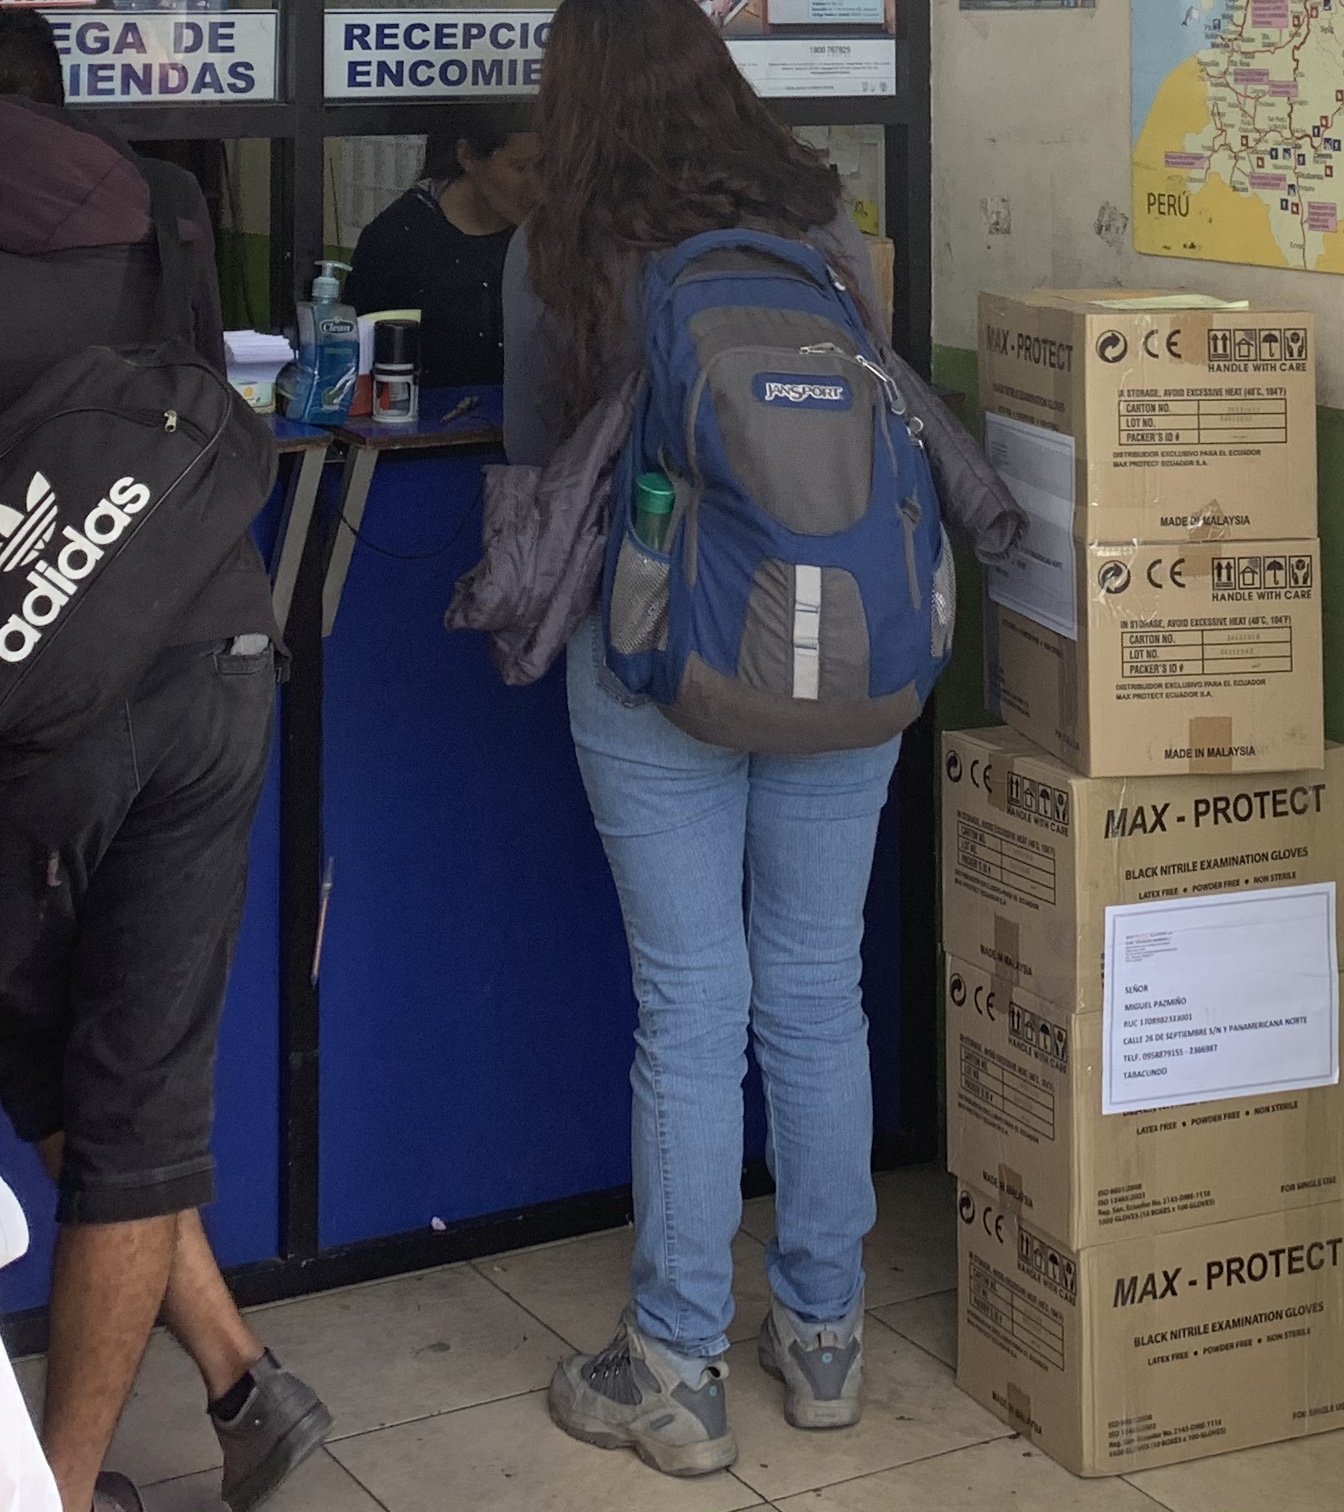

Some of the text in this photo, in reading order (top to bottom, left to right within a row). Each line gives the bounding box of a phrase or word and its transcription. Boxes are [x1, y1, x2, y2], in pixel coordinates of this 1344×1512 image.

[173, 21, 236, 54] DE
[343, 22, 553, 51] RECEPCIO
[347, 59, 542, 88] ENCOMIE
[1146, 191, 1189, 218] PERÚ
[322, 320, 351, 333] Clean
[1016, 332, 1073, 372] PROTECT
[1208, 362, 1307, 373] HANDLE WITH CARE
[765, 381, 844, 401] JANSPORT
[1126, 403, 1171, 413] CARTON NO.
[1212, 590, 1312, 601] HANDLE WITH CARE
[1167, 617, 1246, 628] AVOID EXCESSIVE HEAT
[1129, 634, 1175, 644] CARTON NO.
[1129, 649, 1160, 659] LOT NO.
[1129, 665, 1178, 674] PACKER'S ID
[1164, 746, 1255, 759] MADE IN MALAYSIA
[1103, 802, 1170, 840] MAX
[1193, 784, 1326, 828] PROTECT
[1125, 846, 1309, 881] BLACK NITRILE EXAMINATION GLOVES
[1138, 870, 1296, 901] LATEX FREE POWDER FREE NON STERILE
[1125, 984, 1149, 994] SEÑOR
[1123, 1036, 1143, 1045] CALLE
[1155, 1033, 1164, 1042] DE
[1166, 1027, 1208, 1040] SEPTIEMBRE
[1209, 1025, 1222, 1035] S/N
[1228, 1018, 1284, 1033] PANAMERICANA
[1284, 1016, 1308, 1026] NORTE
[1123, 1067, 1168, 1079] TABACUNDO
[1112, 1267, 1182, 1308] MAX
[1206, 1237, 1343, 1290] PROTECT
[1133, 1301, 1324, 1349] BLACK NITRILE EXAMINATION GLOVES
